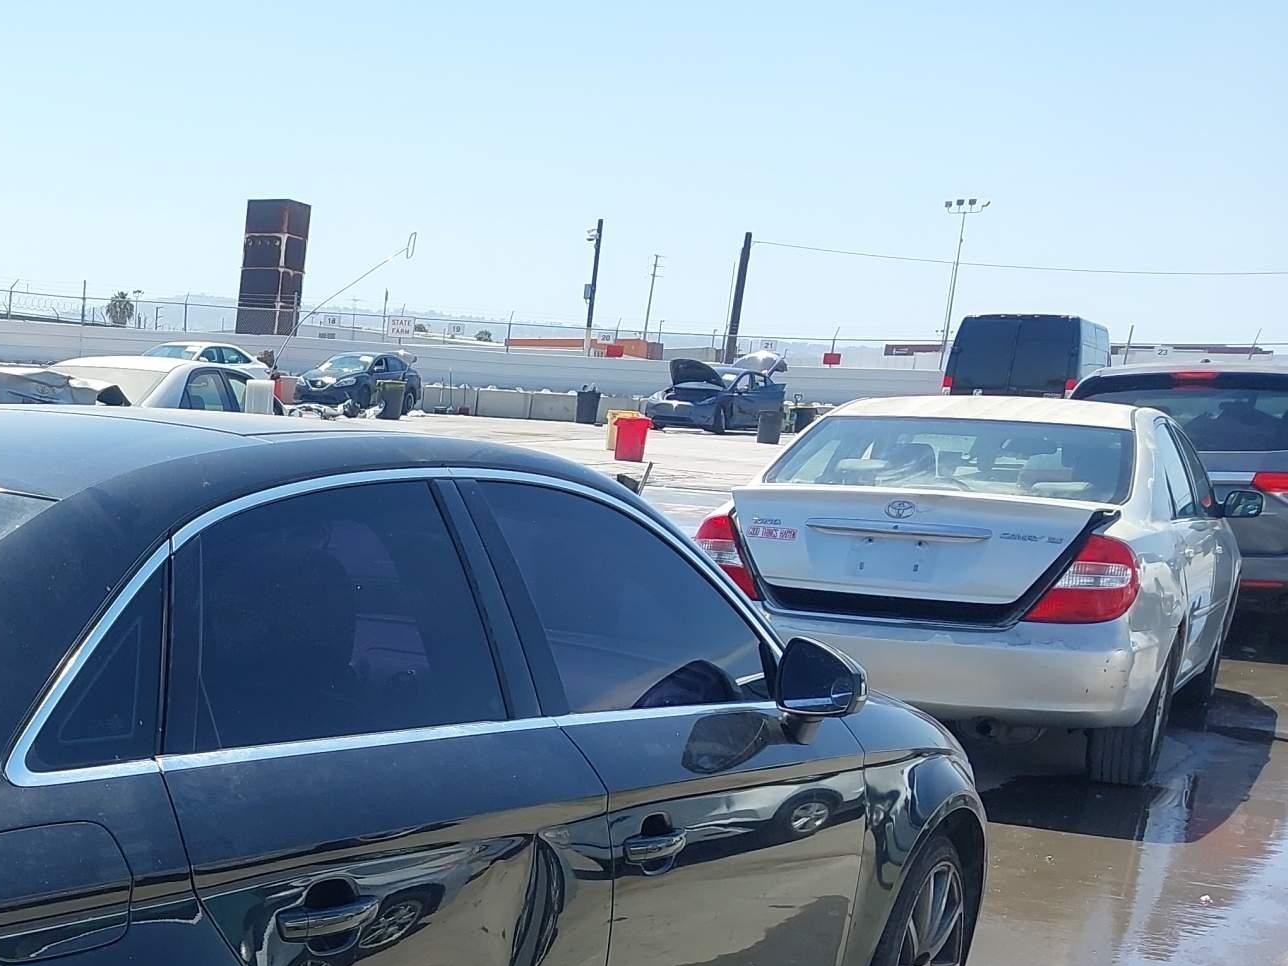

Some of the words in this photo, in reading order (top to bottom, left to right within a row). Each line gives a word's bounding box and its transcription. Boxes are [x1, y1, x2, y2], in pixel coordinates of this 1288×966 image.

[327, 317, 336, 325] 18
[391, 319, 412, 327] STATE
[391, 327, 410, 335] FARM
[452, 325, 461, 333] 19
[600, 334, 611, 342] 20
[1157, 348, 1168, 356] 23
